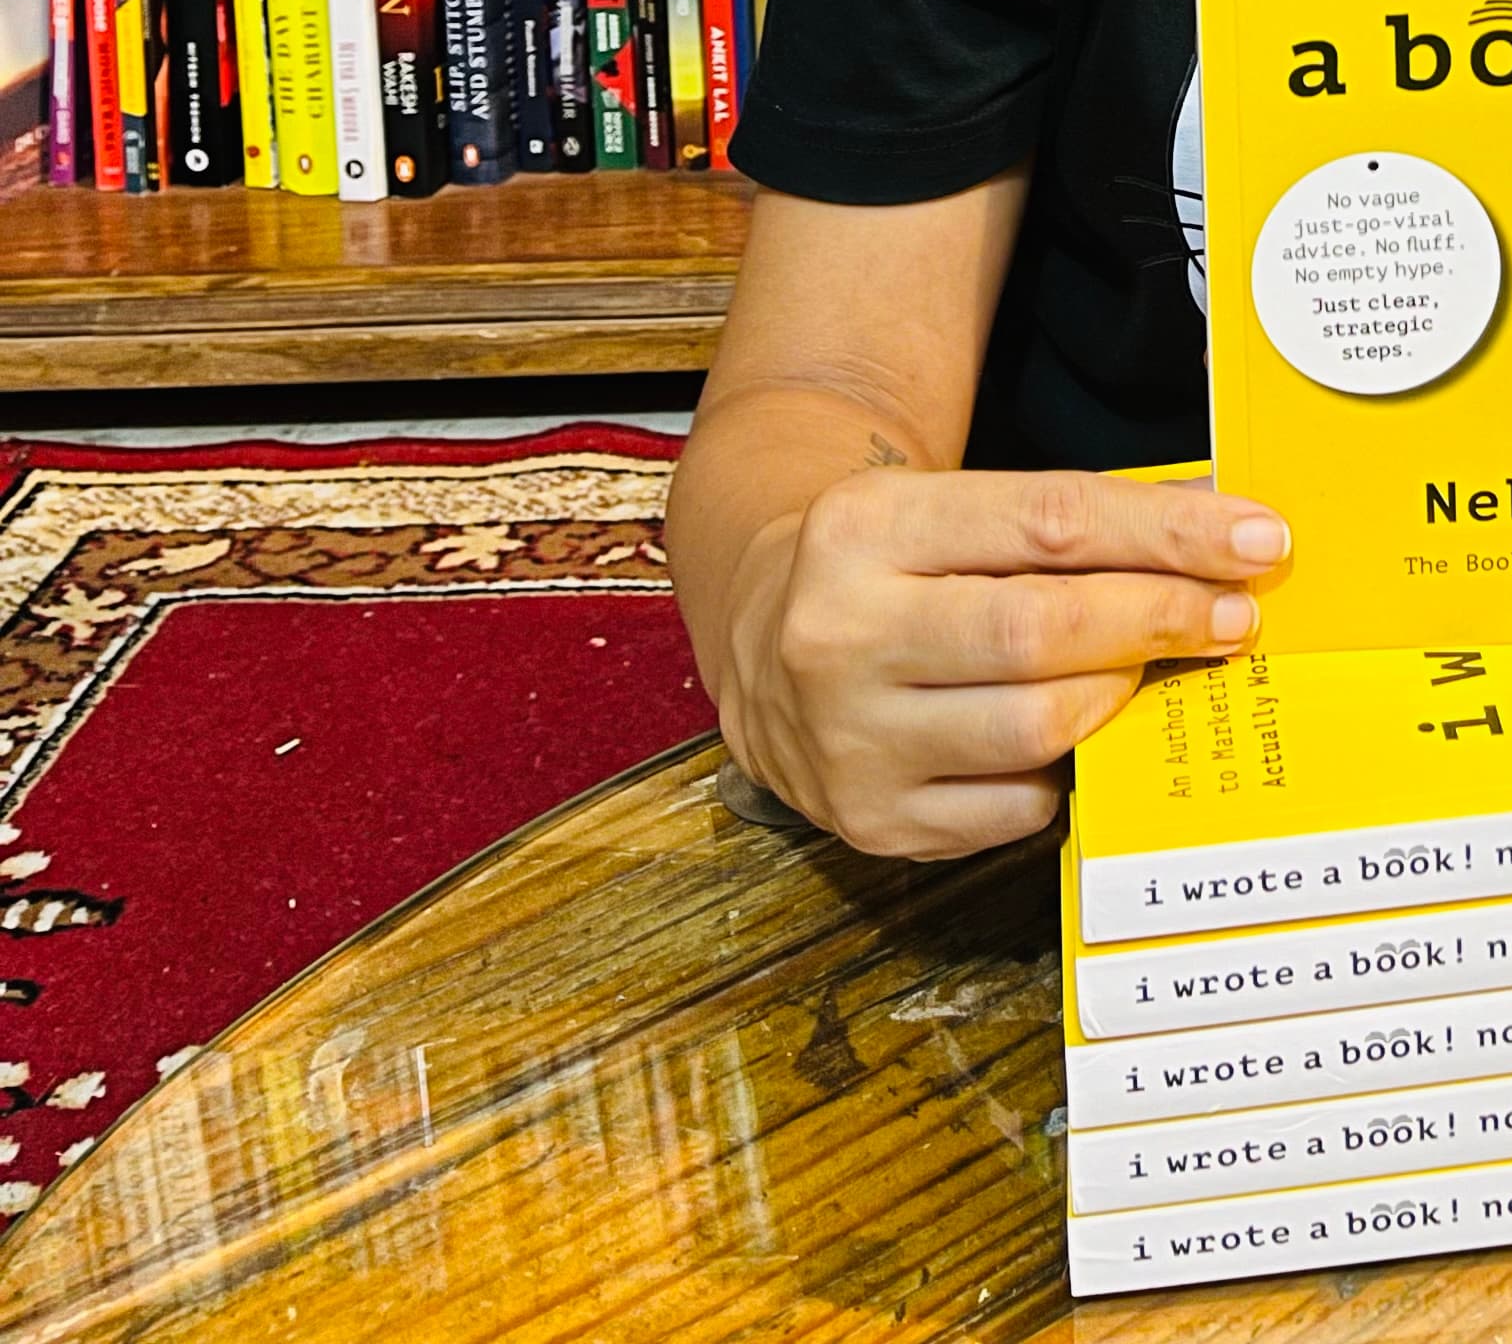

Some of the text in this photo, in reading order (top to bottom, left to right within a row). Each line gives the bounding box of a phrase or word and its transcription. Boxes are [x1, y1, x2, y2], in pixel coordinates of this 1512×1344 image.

[710, 27, 728, 79] ANKIT
[1288, 41, 1347, 99] a
[714, 83, 729, 123] LAL
[1327, 188, 1421, 210] No vague
[1293, 210, 1455, 238] just-go-viral
[1281, 234, 1467, 261] advice. No fluff.
[1295, 258, 1455, 285] No empty hype.
[1312, 290, 1441, 315] Just clear,
[1322, 315, 1434, 338] strategic
[1341, 341, 1414, 363] steps.
[1404, 554, 1450, 577] The
[1143, 880, 1164, 906] i
[1182, 866, 1304, 904] wrote
[1322, 864, 1342, 886] a
[1359, 843, 1473, 882] book!
[1135, 977, 1156, 1004] i
[1173, 962, 1295, 1001] wrote
[1313, 959, 1333, 982] a
[1350, 940, 1466, 977] book!
[1125, 1067, 1145, 1094] i
[1163, 1051, 1285, 1090] wrote
[1303, 1048, 1323, 1071] a
[1340, 1028, 1455, 1066] book!
[1128, 1153, 1149, 1180] i
[1166, 1138, 1287, 1176] wrote
[1305, 1134, 1326, 1157] a
[1342, 1114, 1457, 1151] book!
[1132, 1237, 1153, 1262] i
[1169, 1222, 1290, 1257] wrote
[1309, 1219, 1329, 1240] a
[1345, 1199, 1460, 1236] book!
